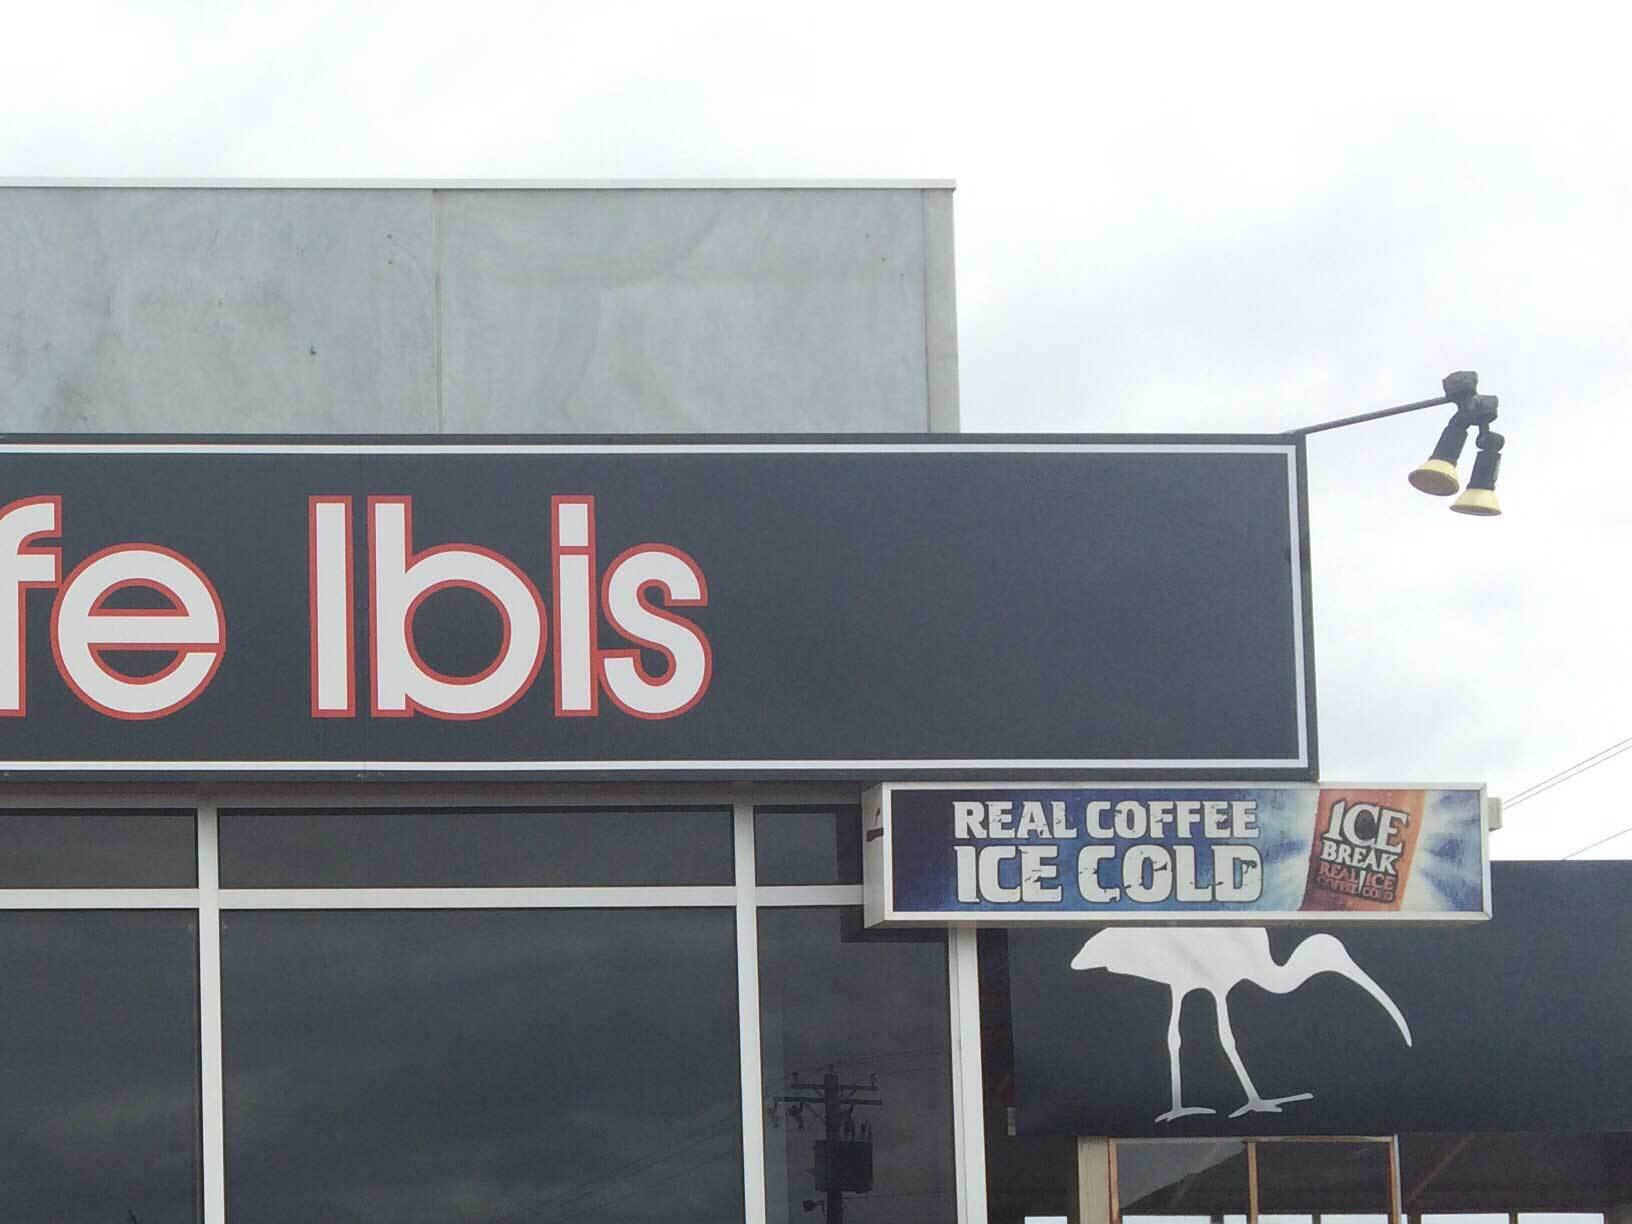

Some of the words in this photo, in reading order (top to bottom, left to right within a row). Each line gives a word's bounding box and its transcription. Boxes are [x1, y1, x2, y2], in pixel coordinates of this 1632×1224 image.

[309, 496, 713, 719] Ibis
[952, 801, 1077, 840] REAL
[1085, 800, 1261, 840] COFFEE
[1323, 800, 1409, 854] ICE
[953, 844, 1063, 904] ICE
[1077, 844, 1264, 904] COLD
[1318, 860, 1359, 883] REAL
[1320, 838, 1399, 875] BREAK
